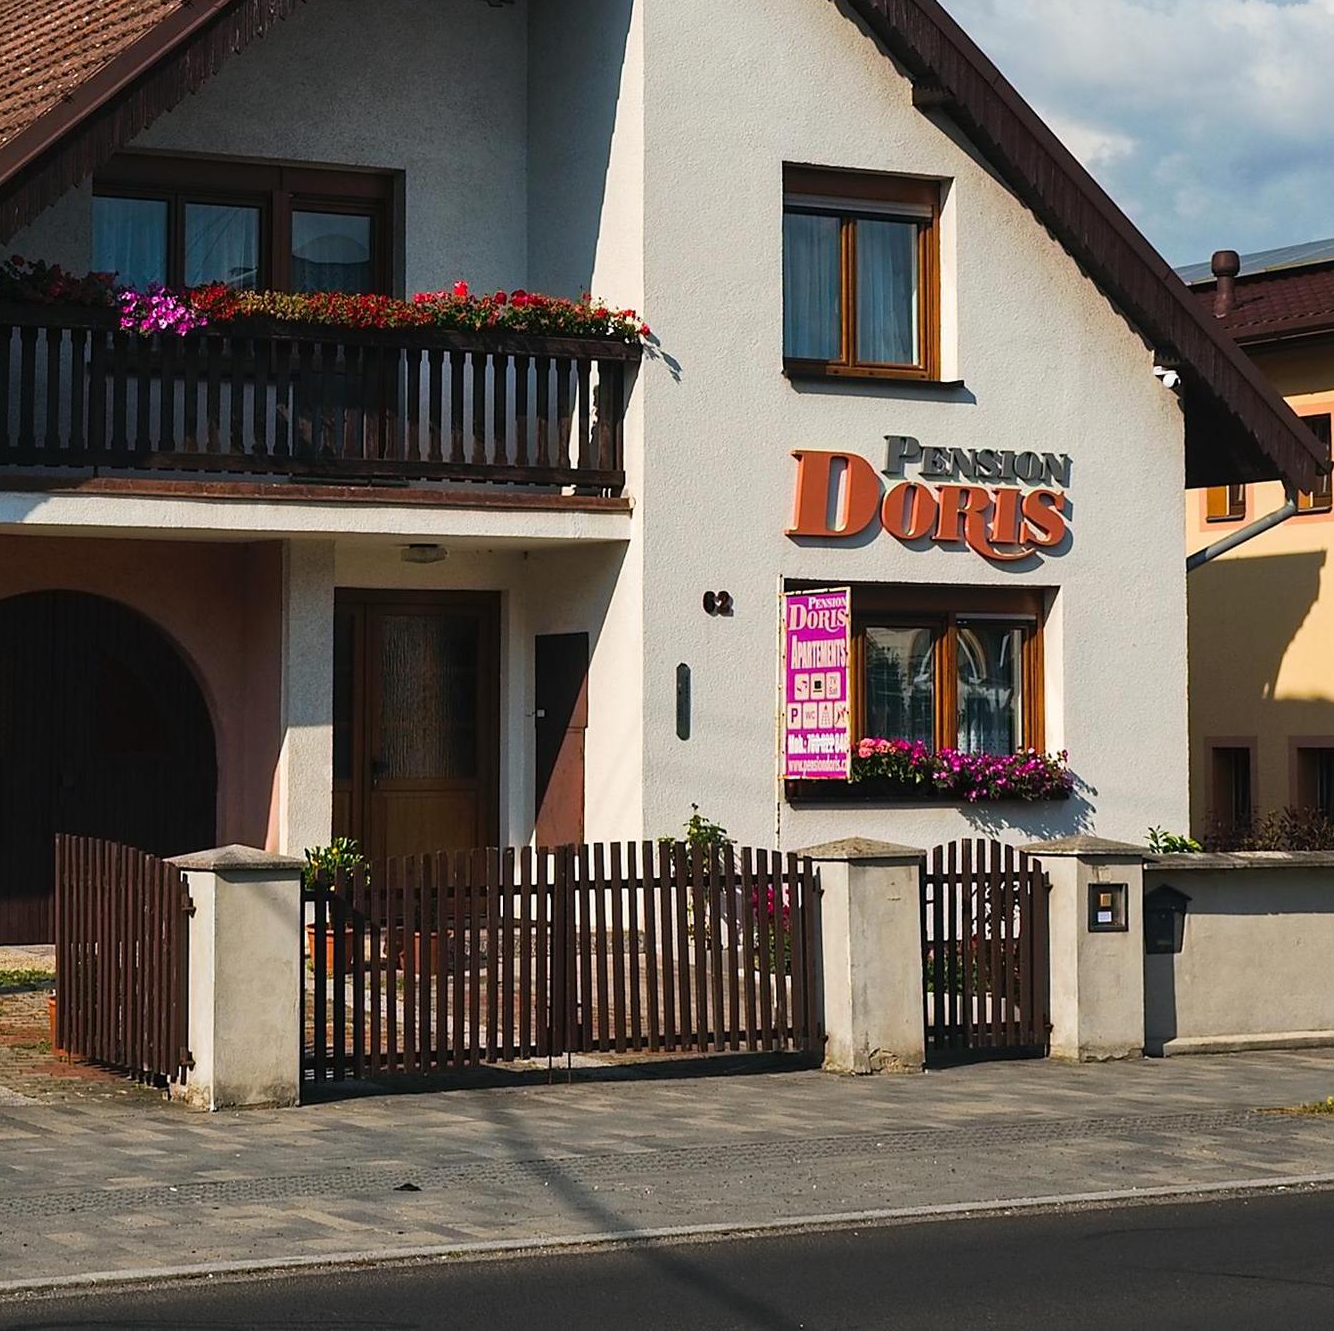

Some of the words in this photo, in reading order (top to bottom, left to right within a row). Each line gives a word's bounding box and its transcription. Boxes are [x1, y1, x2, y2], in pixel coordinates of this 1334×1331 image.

[881, 435, 1072, 486] PENSION
[785, 449, 1068, 560] DORIS
[703, 591, 733, 617] 62
[808, 596, 846, 610] PENSION
[788, 604, 847, 633] DORIS
[791, 708, 798, 723] P
